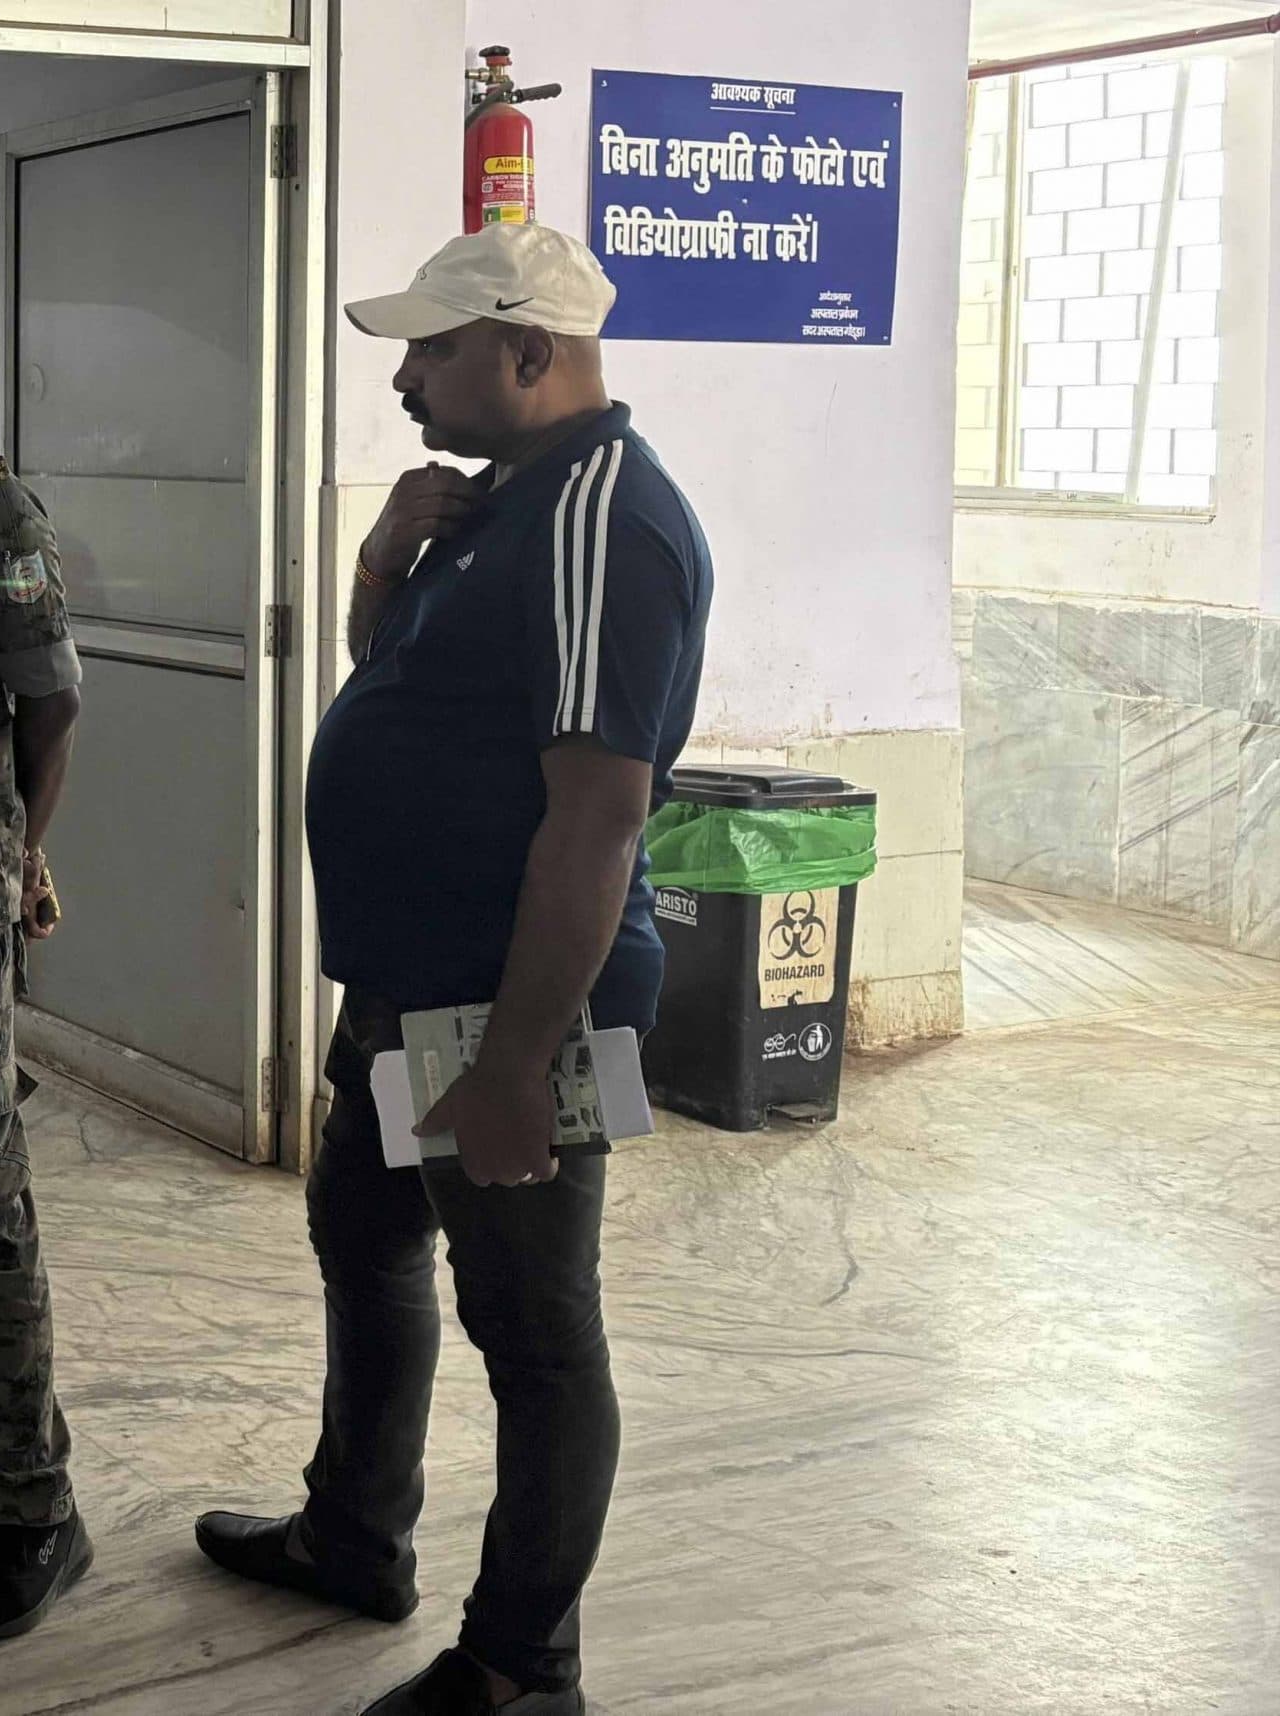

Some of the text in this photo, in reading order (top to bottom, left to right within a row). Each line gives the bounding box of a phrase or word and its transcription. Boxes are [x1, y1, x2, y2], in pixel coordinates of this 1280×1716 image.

[711, 83, 796, 109] आवश्यक सूचना
[600, 124, 890, 194] बिना अनुमति के फोटो एवं
[604, 204, 818, 262] विडियोग्राफी ना करें।
[655, 890, 697, 916] ARISTO
[764, 964, 825, 982] BIOHAZARD
